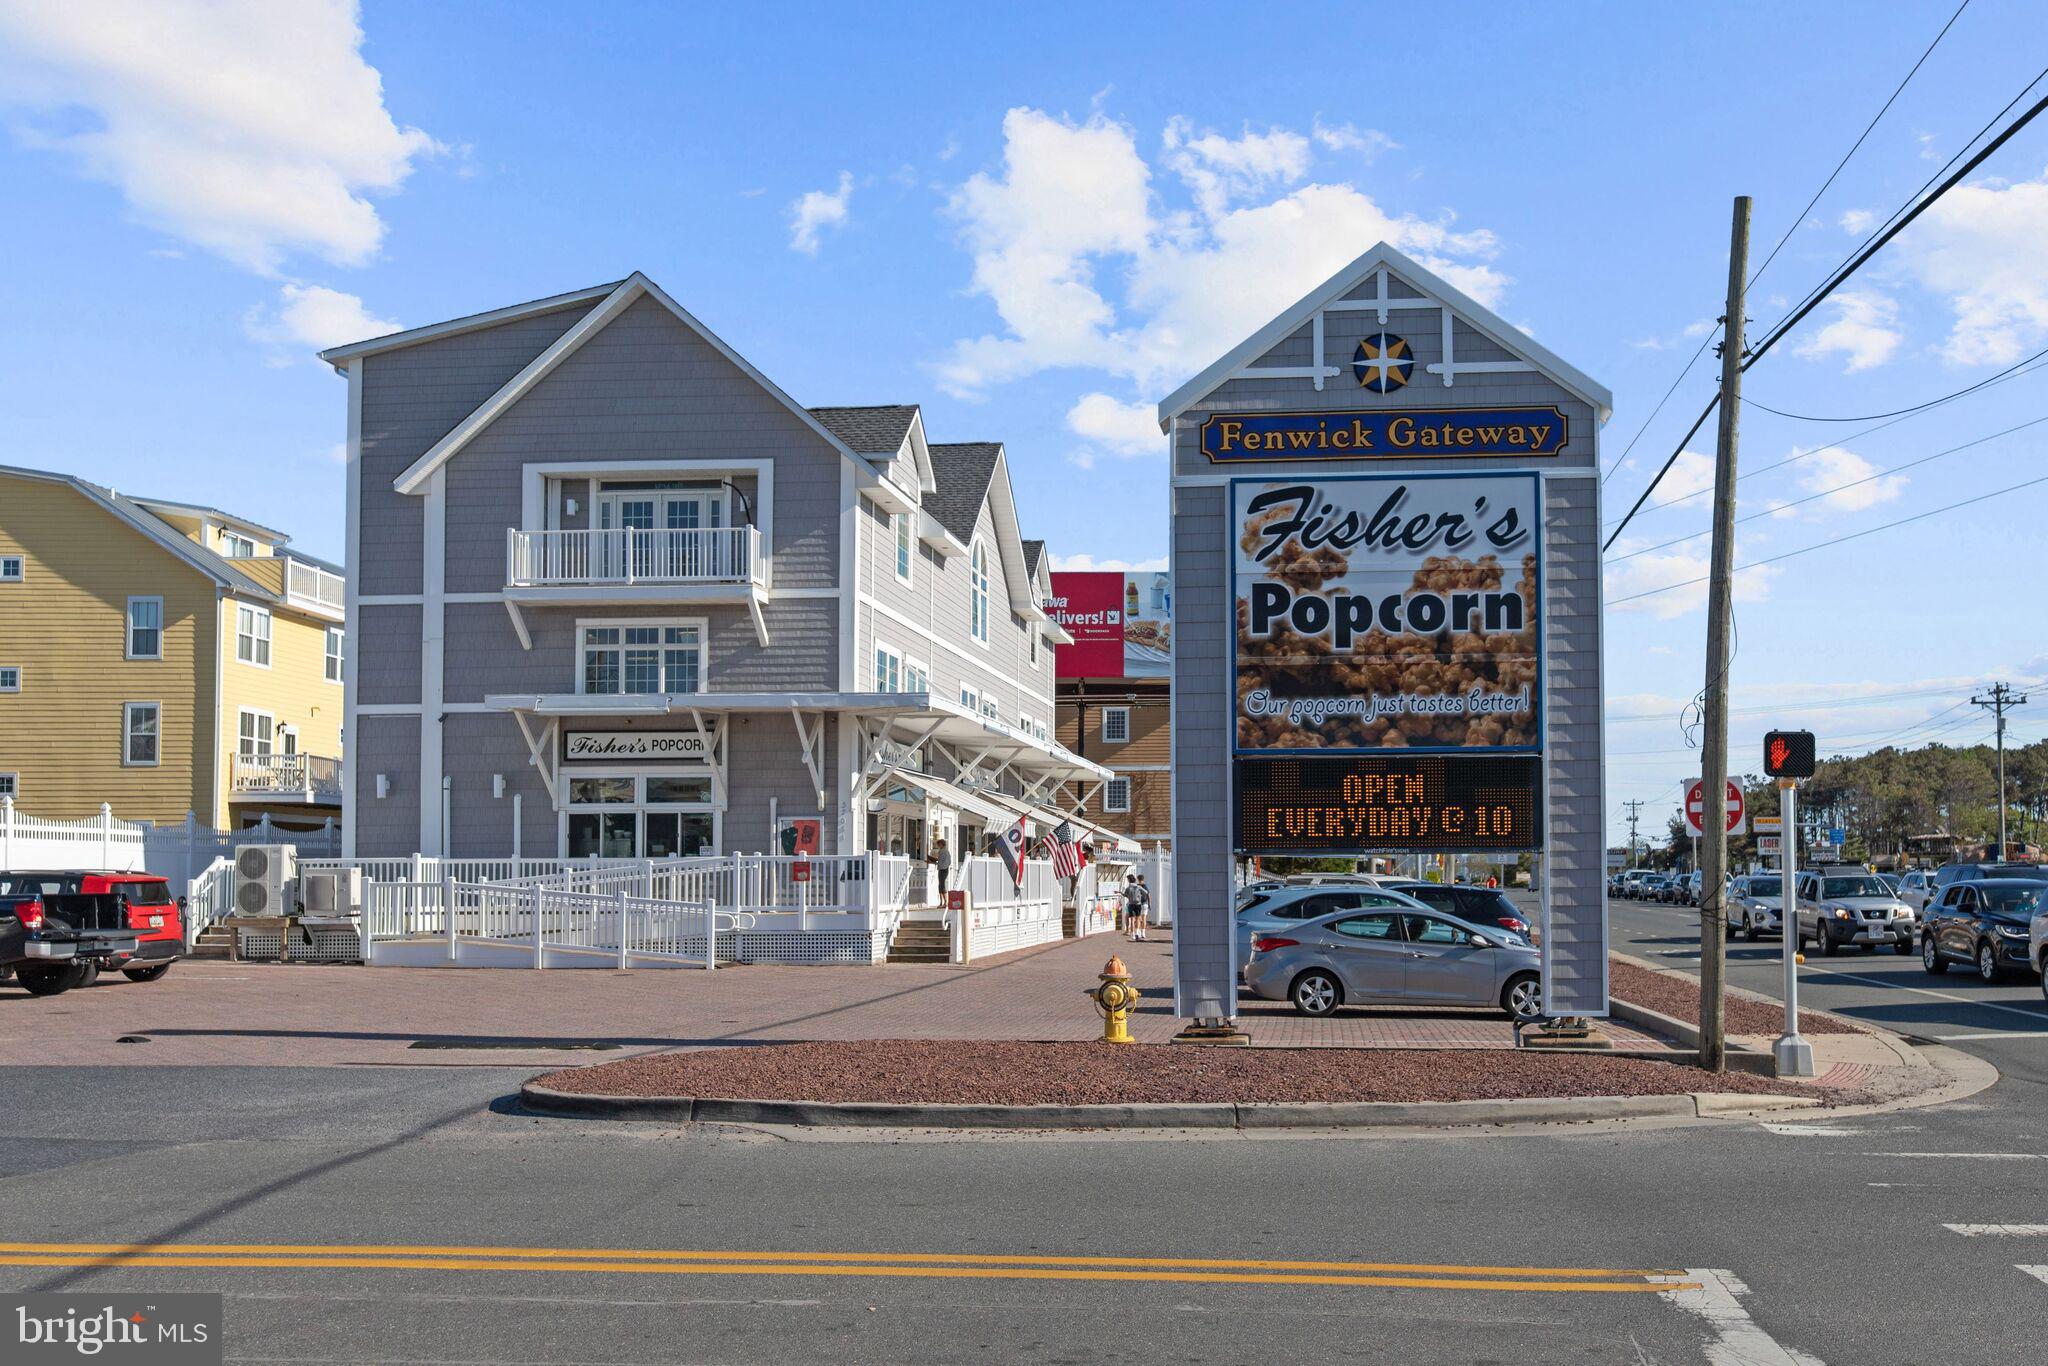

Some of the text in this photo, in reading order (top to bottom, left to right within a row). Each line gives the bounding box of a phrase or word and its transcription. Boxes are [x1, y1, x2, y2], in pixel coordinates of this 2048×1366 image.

[1220, 417, 1551, 450] Fenwick Gateway
[1247, 485, 1527, 562] Fisher's
[1252, 583, 1523, 648] Popcorn
[1248, 687, 1529, 723] Our popcorn just tastes better!
[571, 736, 704, 754] Fisher's POPCOR
[1343, 774, 1424, 804] OPEN
[1267, 806, 1512, 837] EVERYDAY @ 10
